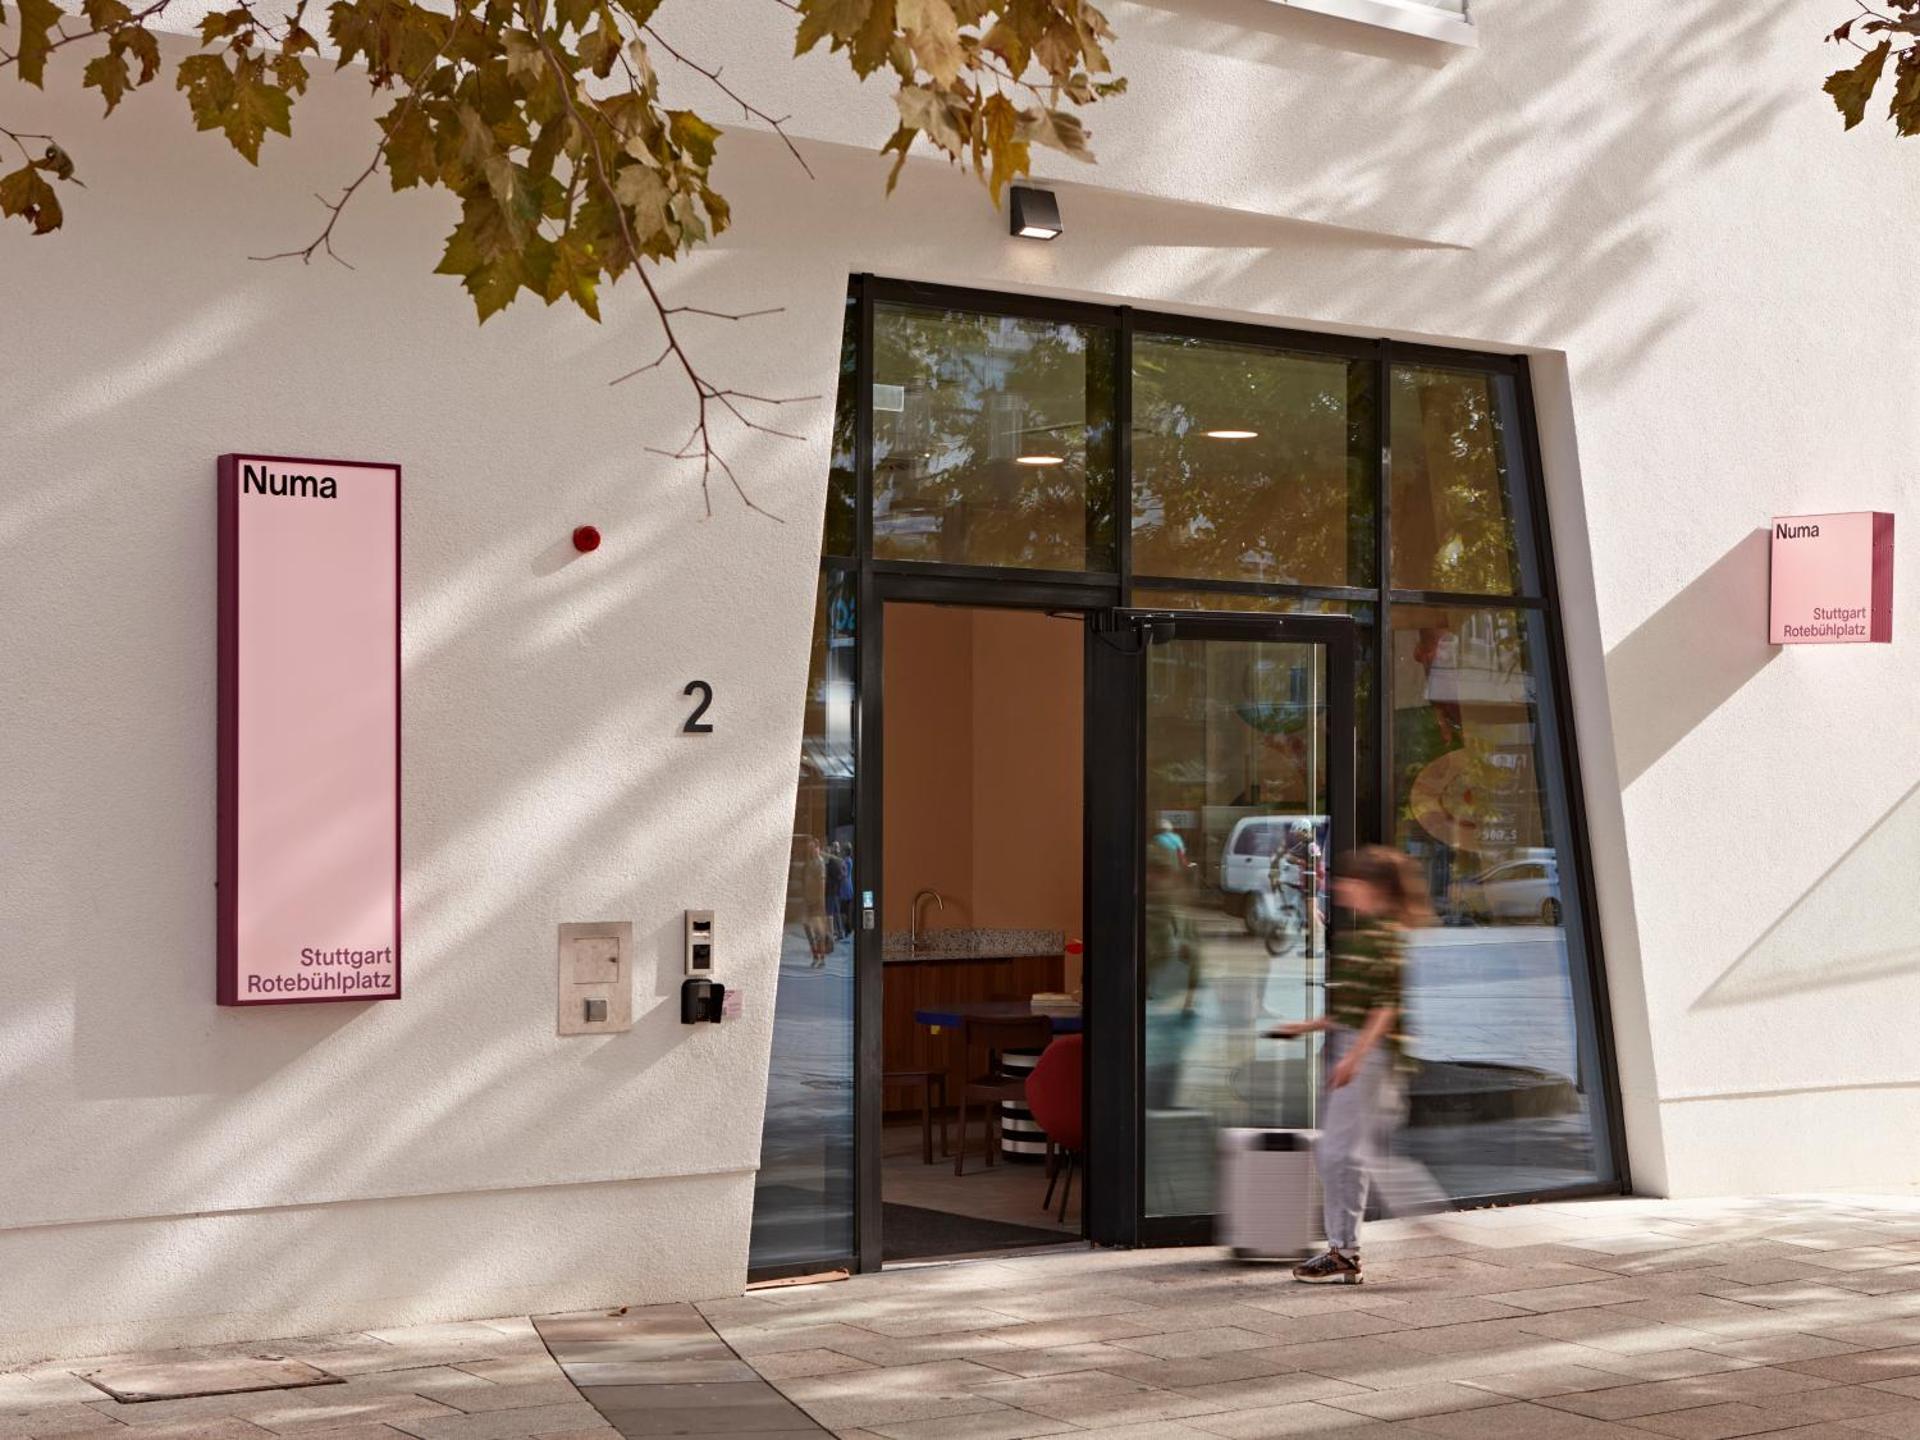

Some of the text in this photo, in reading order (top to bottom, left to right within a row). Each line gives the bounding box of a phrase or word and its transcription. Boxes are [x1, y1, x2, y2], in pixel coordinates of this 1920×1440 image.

[243, 464, 337, 499] Numa
[1776, 523, 1820, 540] Numa
[1813, 607, 1867, 622] Stuttgart
[1783, 623, 1866, 639] Rotebühlplatz
[683, 680, 713, 733] 2
[300, 946, 392, 969] Stuttgart
[247, 971, 392, 994] Rotebühlplatz
